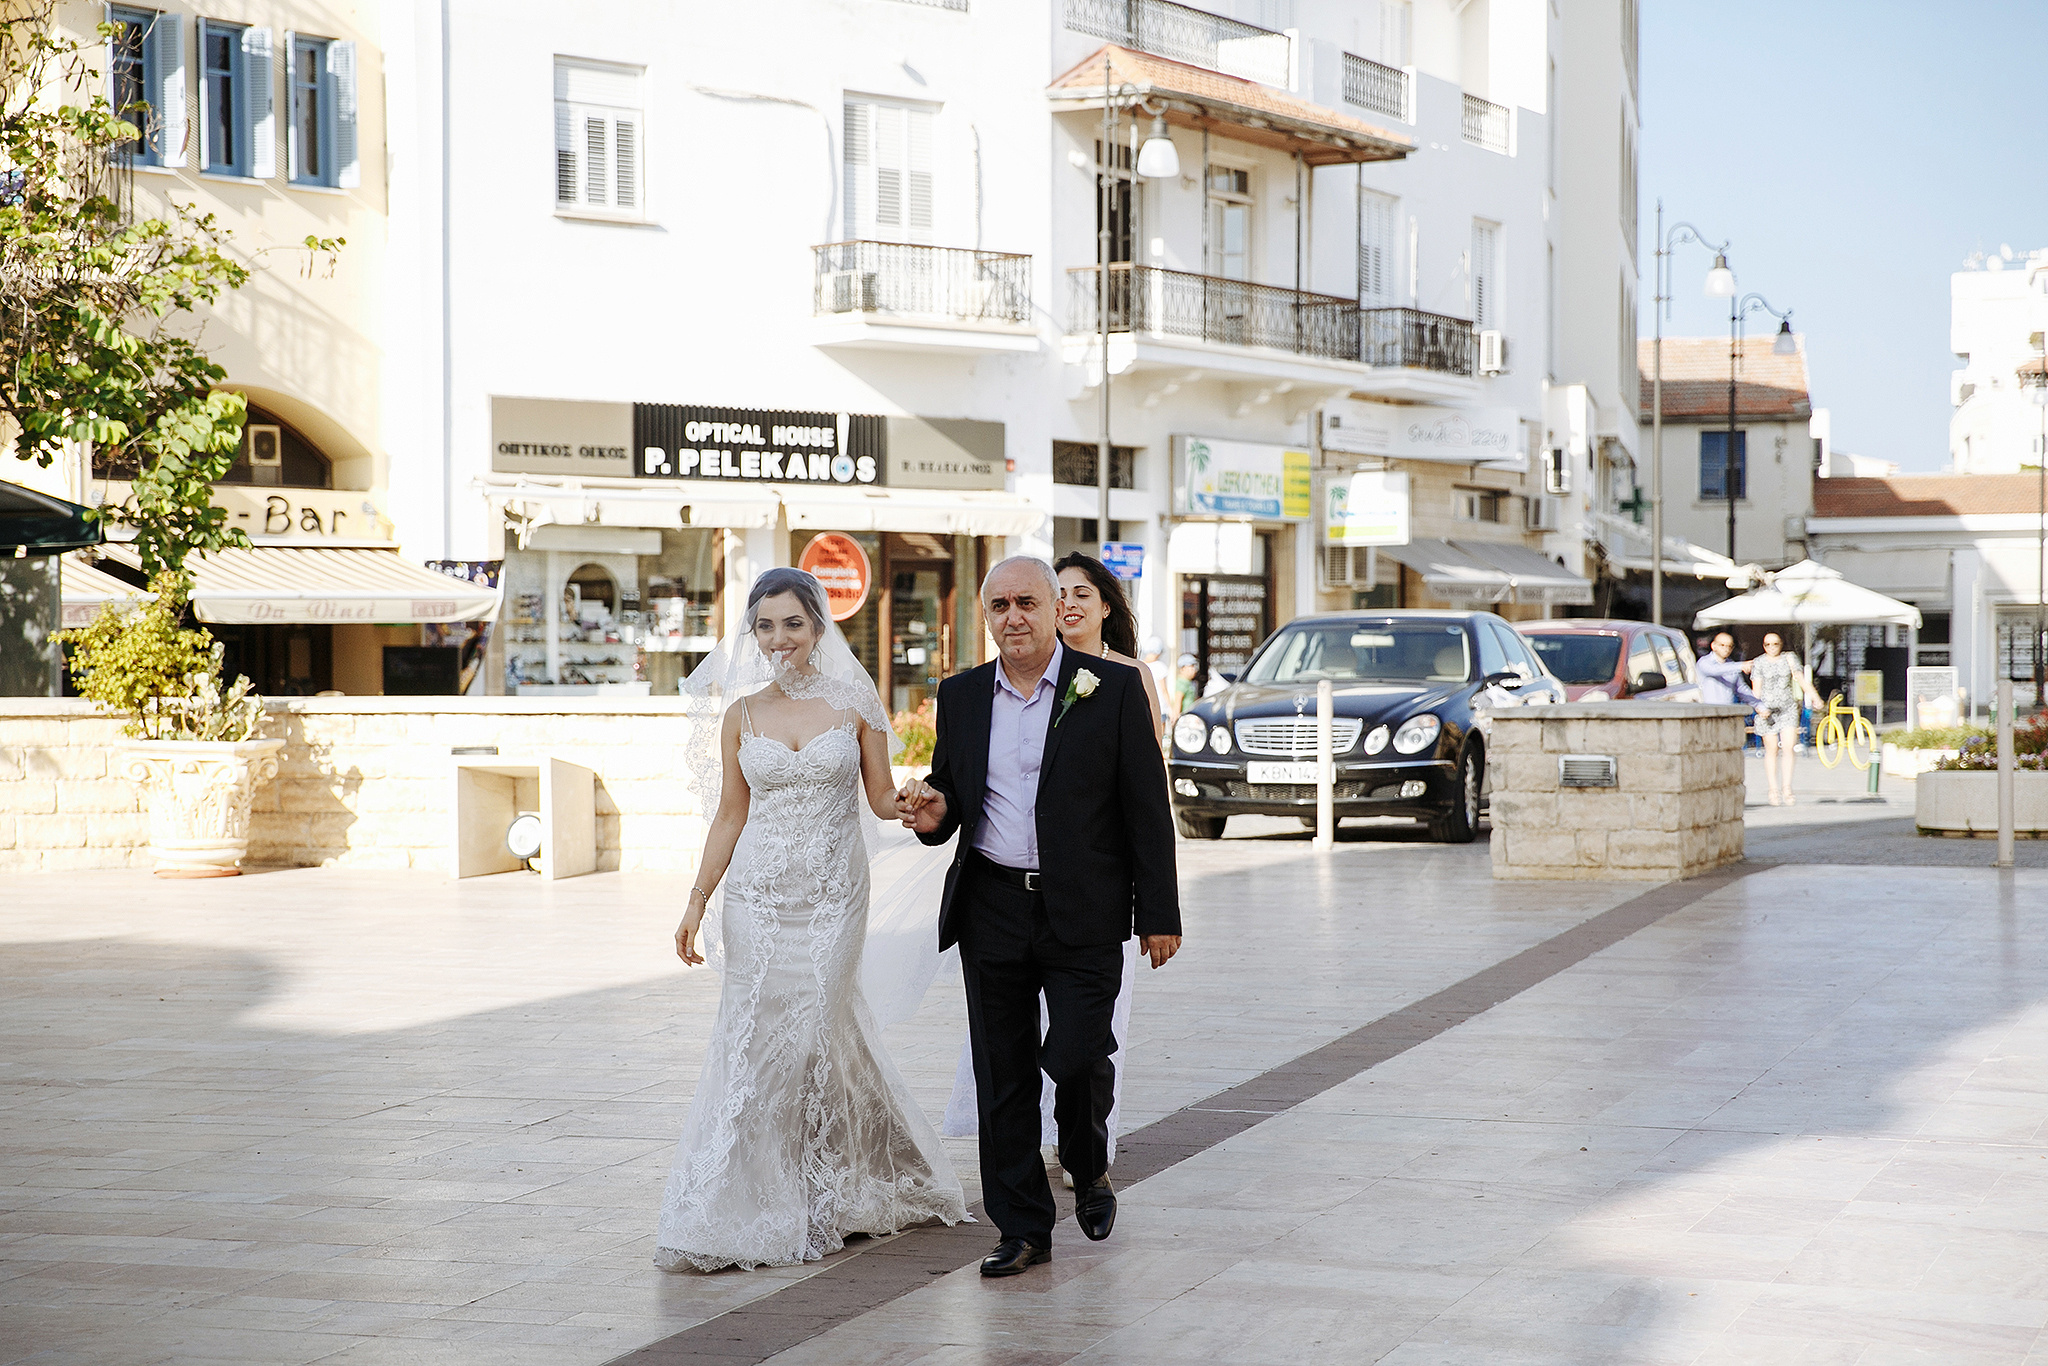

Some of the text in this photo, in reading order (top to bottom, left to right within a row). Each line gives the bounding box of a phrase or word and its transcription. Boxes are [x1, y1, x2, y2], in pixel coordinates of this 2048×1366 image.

[685, 420, 835, 448] OPTICAL HOUSE
[498, 442, 628, 460] ΟΠΤΙΚΟΣ ΟΙΚΟΣ
[644, 446, 877, 483] P. PELEKANOS
[264, 495, 346, 535] Bar
